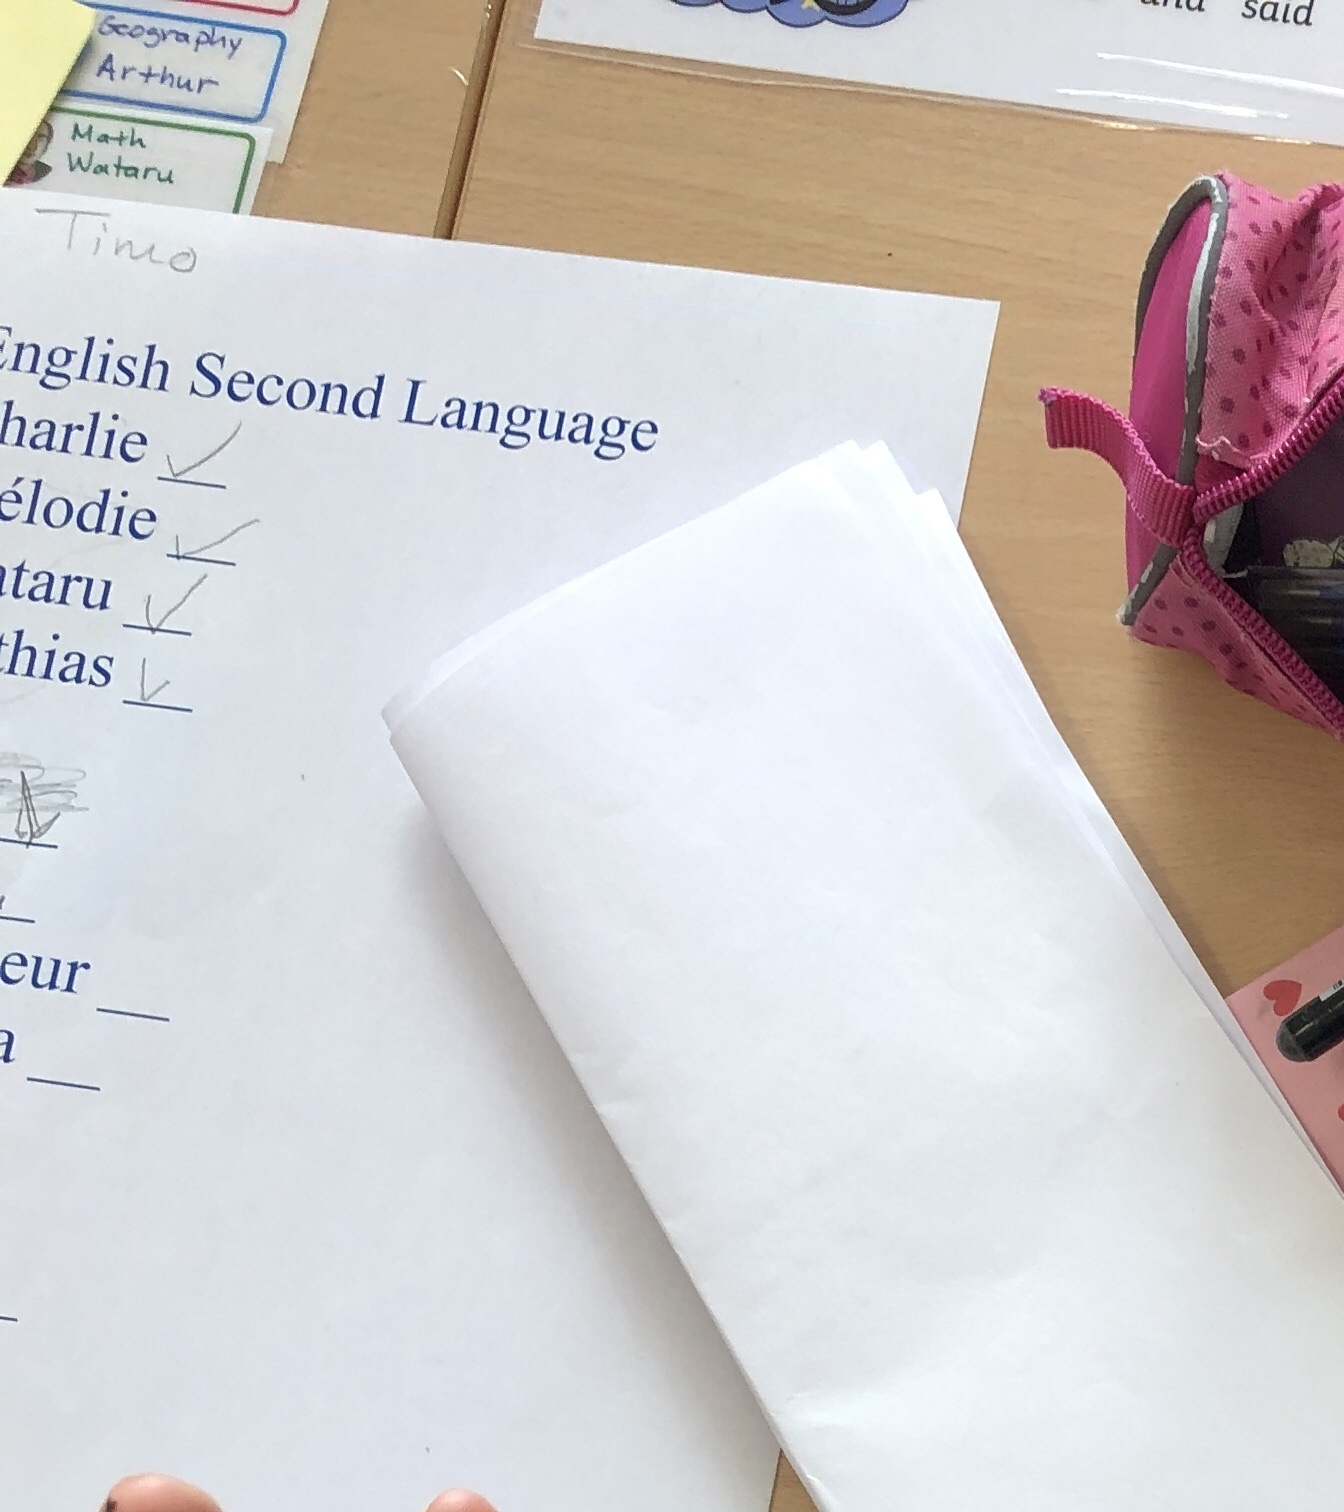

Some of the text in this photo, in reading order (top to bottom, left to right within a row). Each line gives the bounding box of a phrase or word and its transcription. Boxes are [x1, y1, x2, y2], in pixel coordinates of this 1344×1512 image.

[97, 15, 243, 60] Geography
[96, 53, 220, 93] Arthur
[71, 122, 147, 149] Math
[67, 151, 174, 184] Wataru
[35, 207, 198, 274] Timo
[0, 399, 148, 464] harlie
[188, 351, 386, 421] Second
[398, 377, 660, 461] Language
[0, 476, 157, 541] élodie
[0, 559, 113, 611] taru
